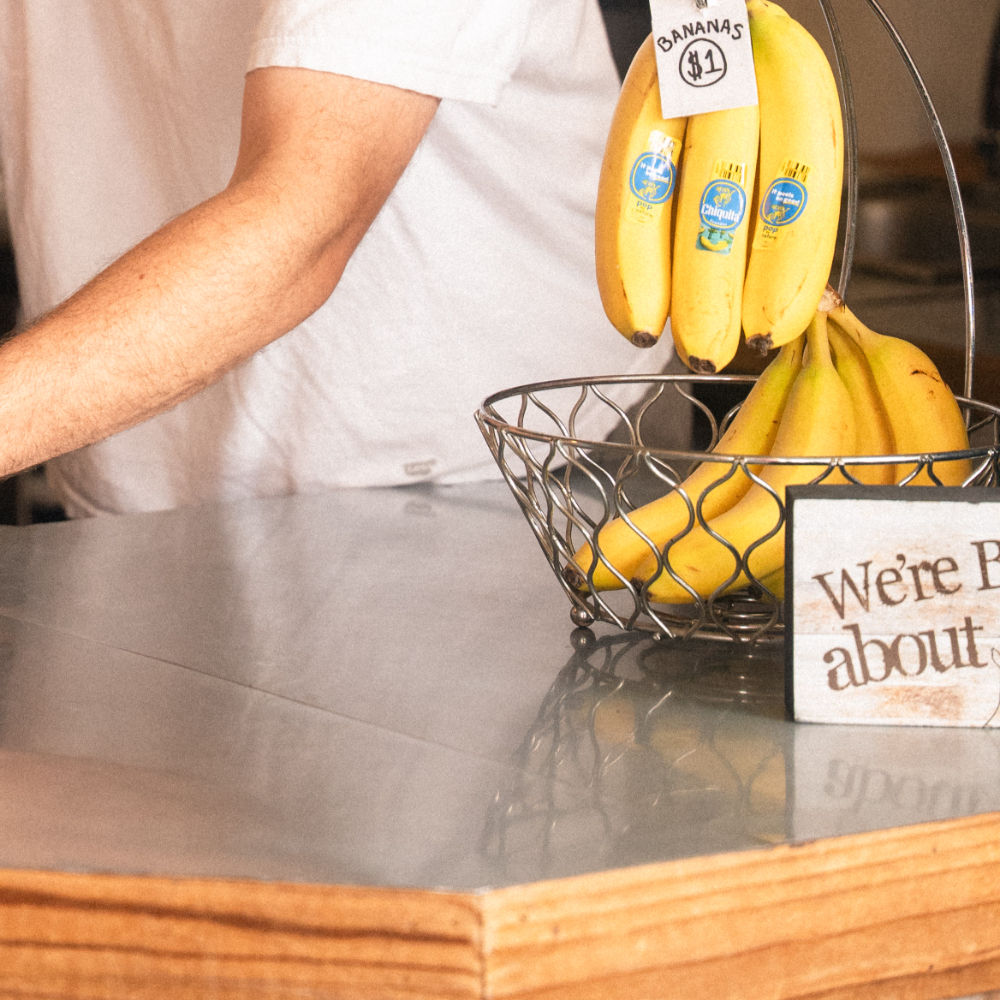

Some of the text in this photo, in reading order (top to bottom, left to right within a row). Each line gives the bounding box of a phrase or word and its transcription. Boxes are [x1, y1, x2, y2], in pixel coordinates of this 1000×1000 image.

[657, 18, 744, 53] BANANAS
[687, 48, 723, 81] $1
[811, 553, 963, 620] We're
[822, 616, 988, 692] about
